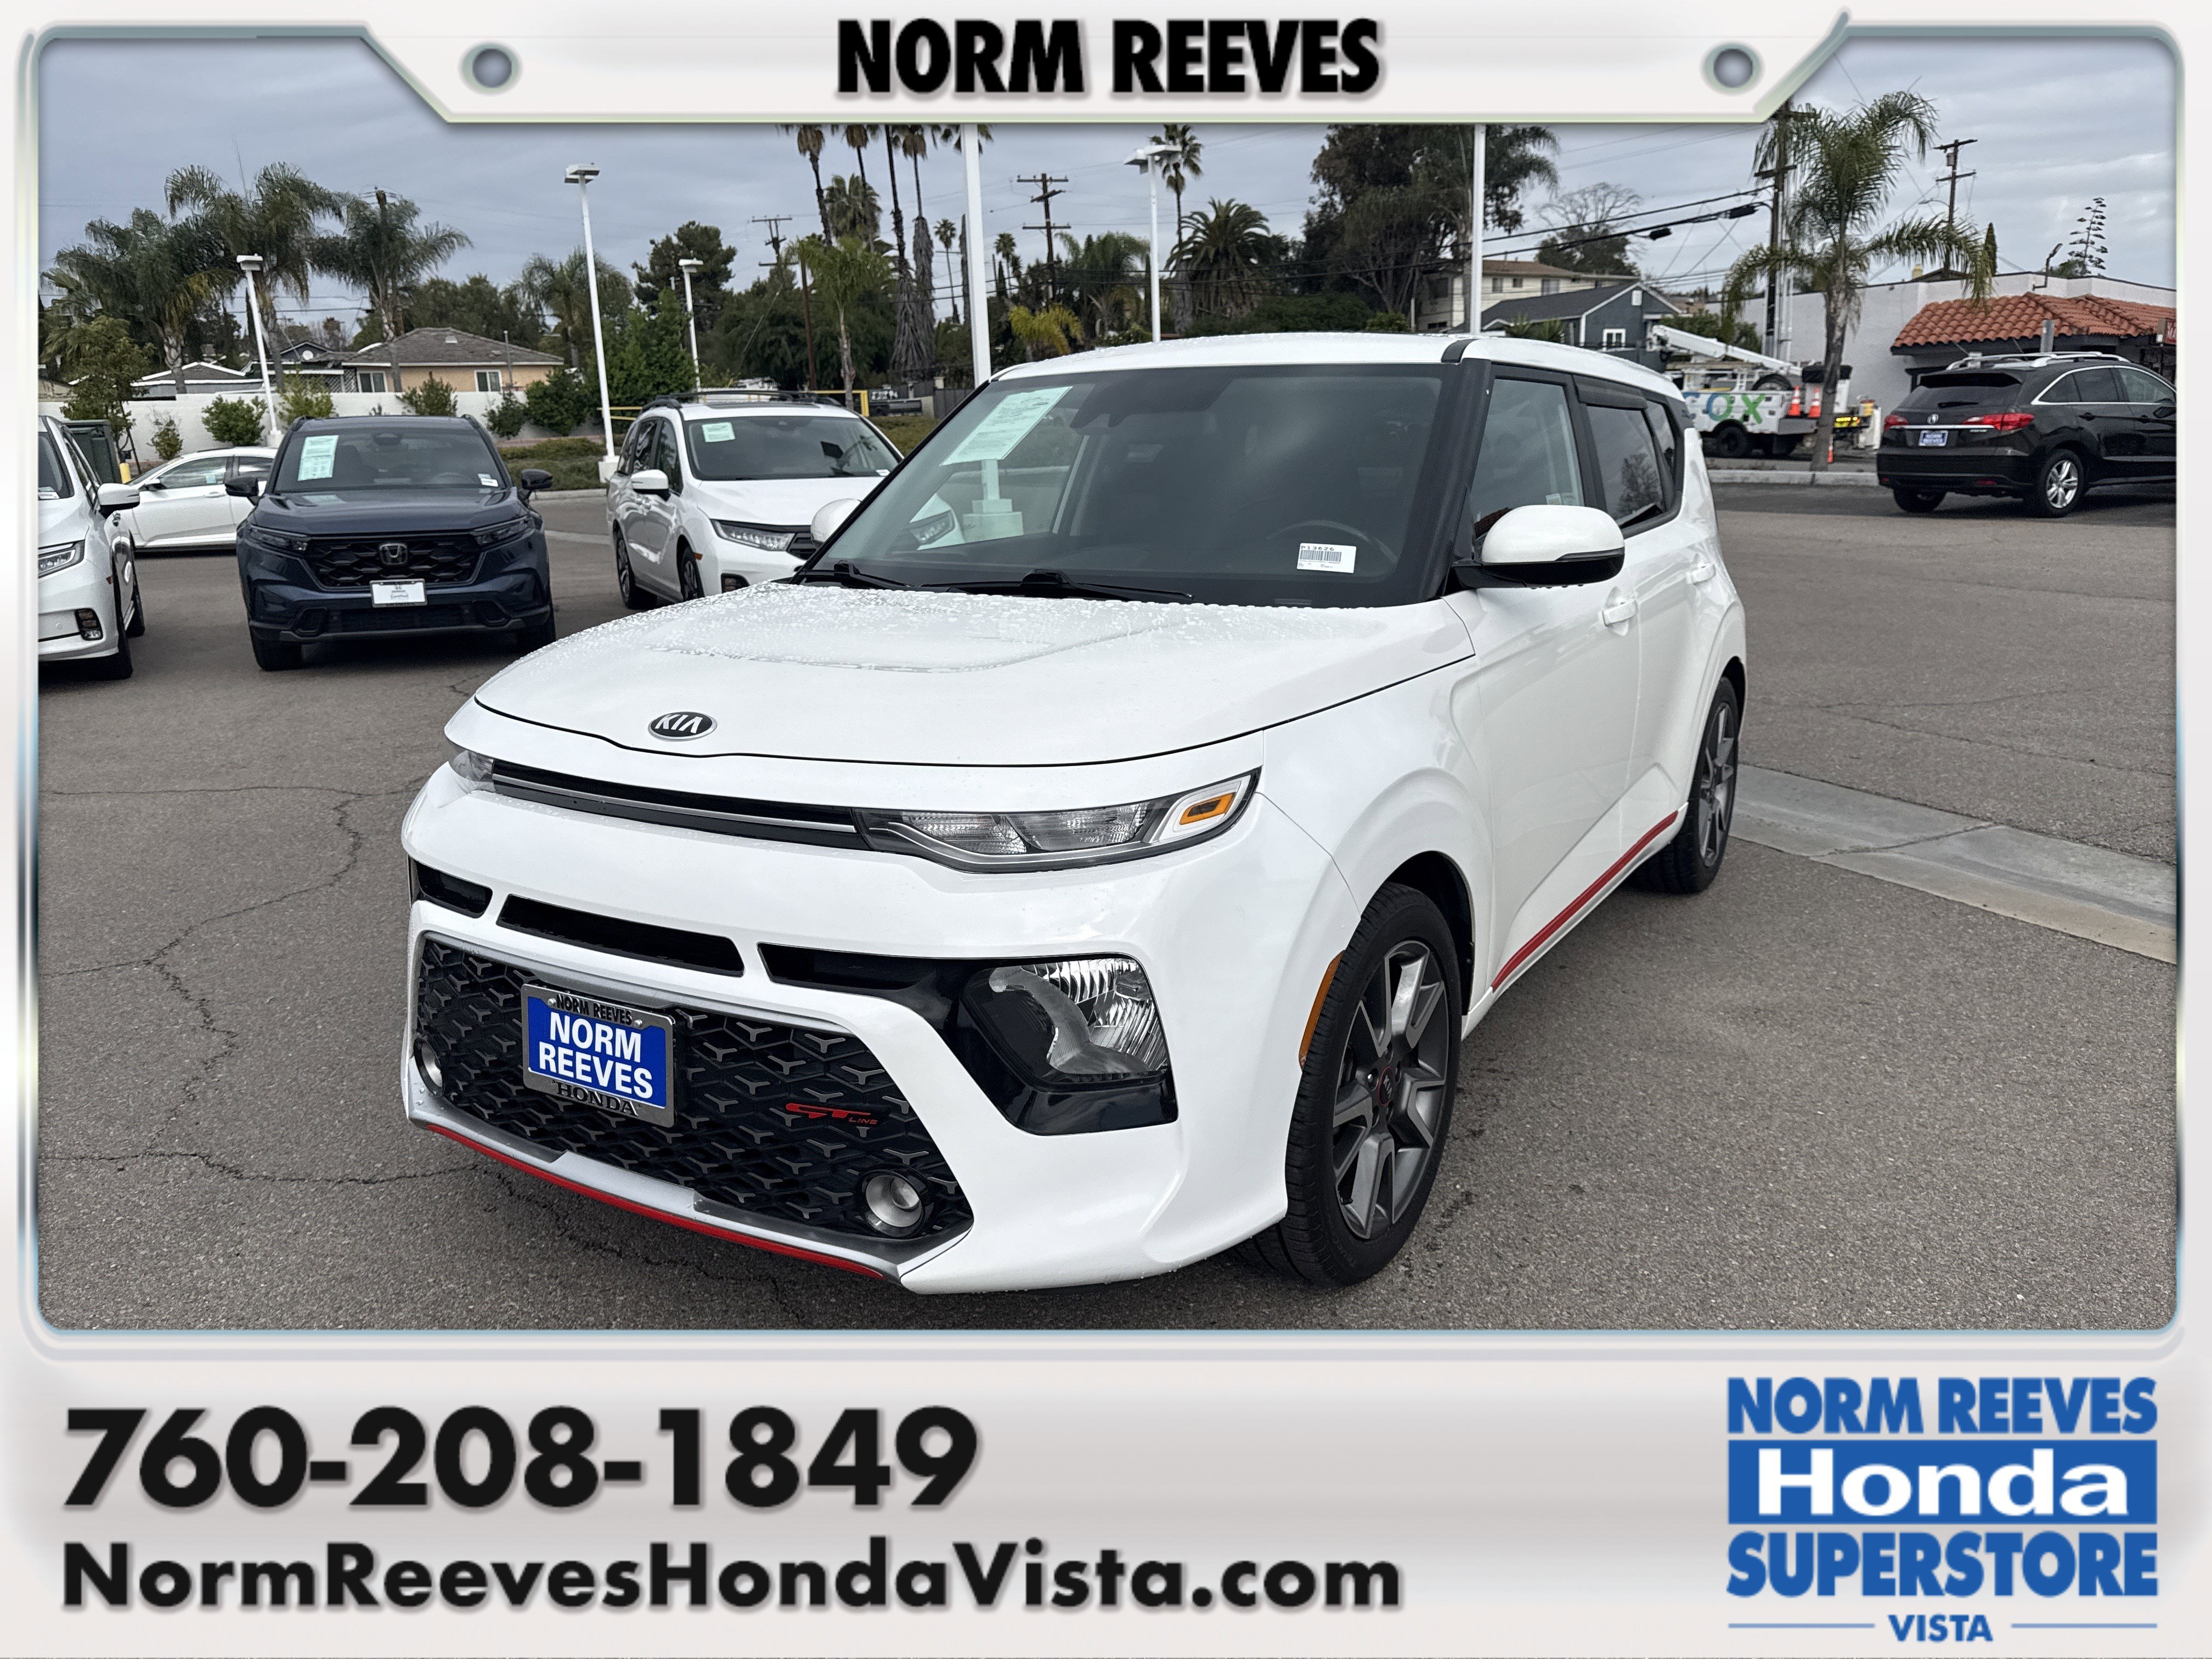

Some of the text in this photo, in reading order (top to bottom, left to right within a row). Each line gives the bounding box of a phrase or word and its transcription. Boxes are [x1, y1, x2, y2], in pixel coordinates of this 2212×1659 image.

[654, 714, 703, 733] KIA
[556, 994, 633, 1025] NORM REEVES
[539, 1011, 653, 1099] NORM REEVES
[556, 1081, 639, 1116] HONDA
